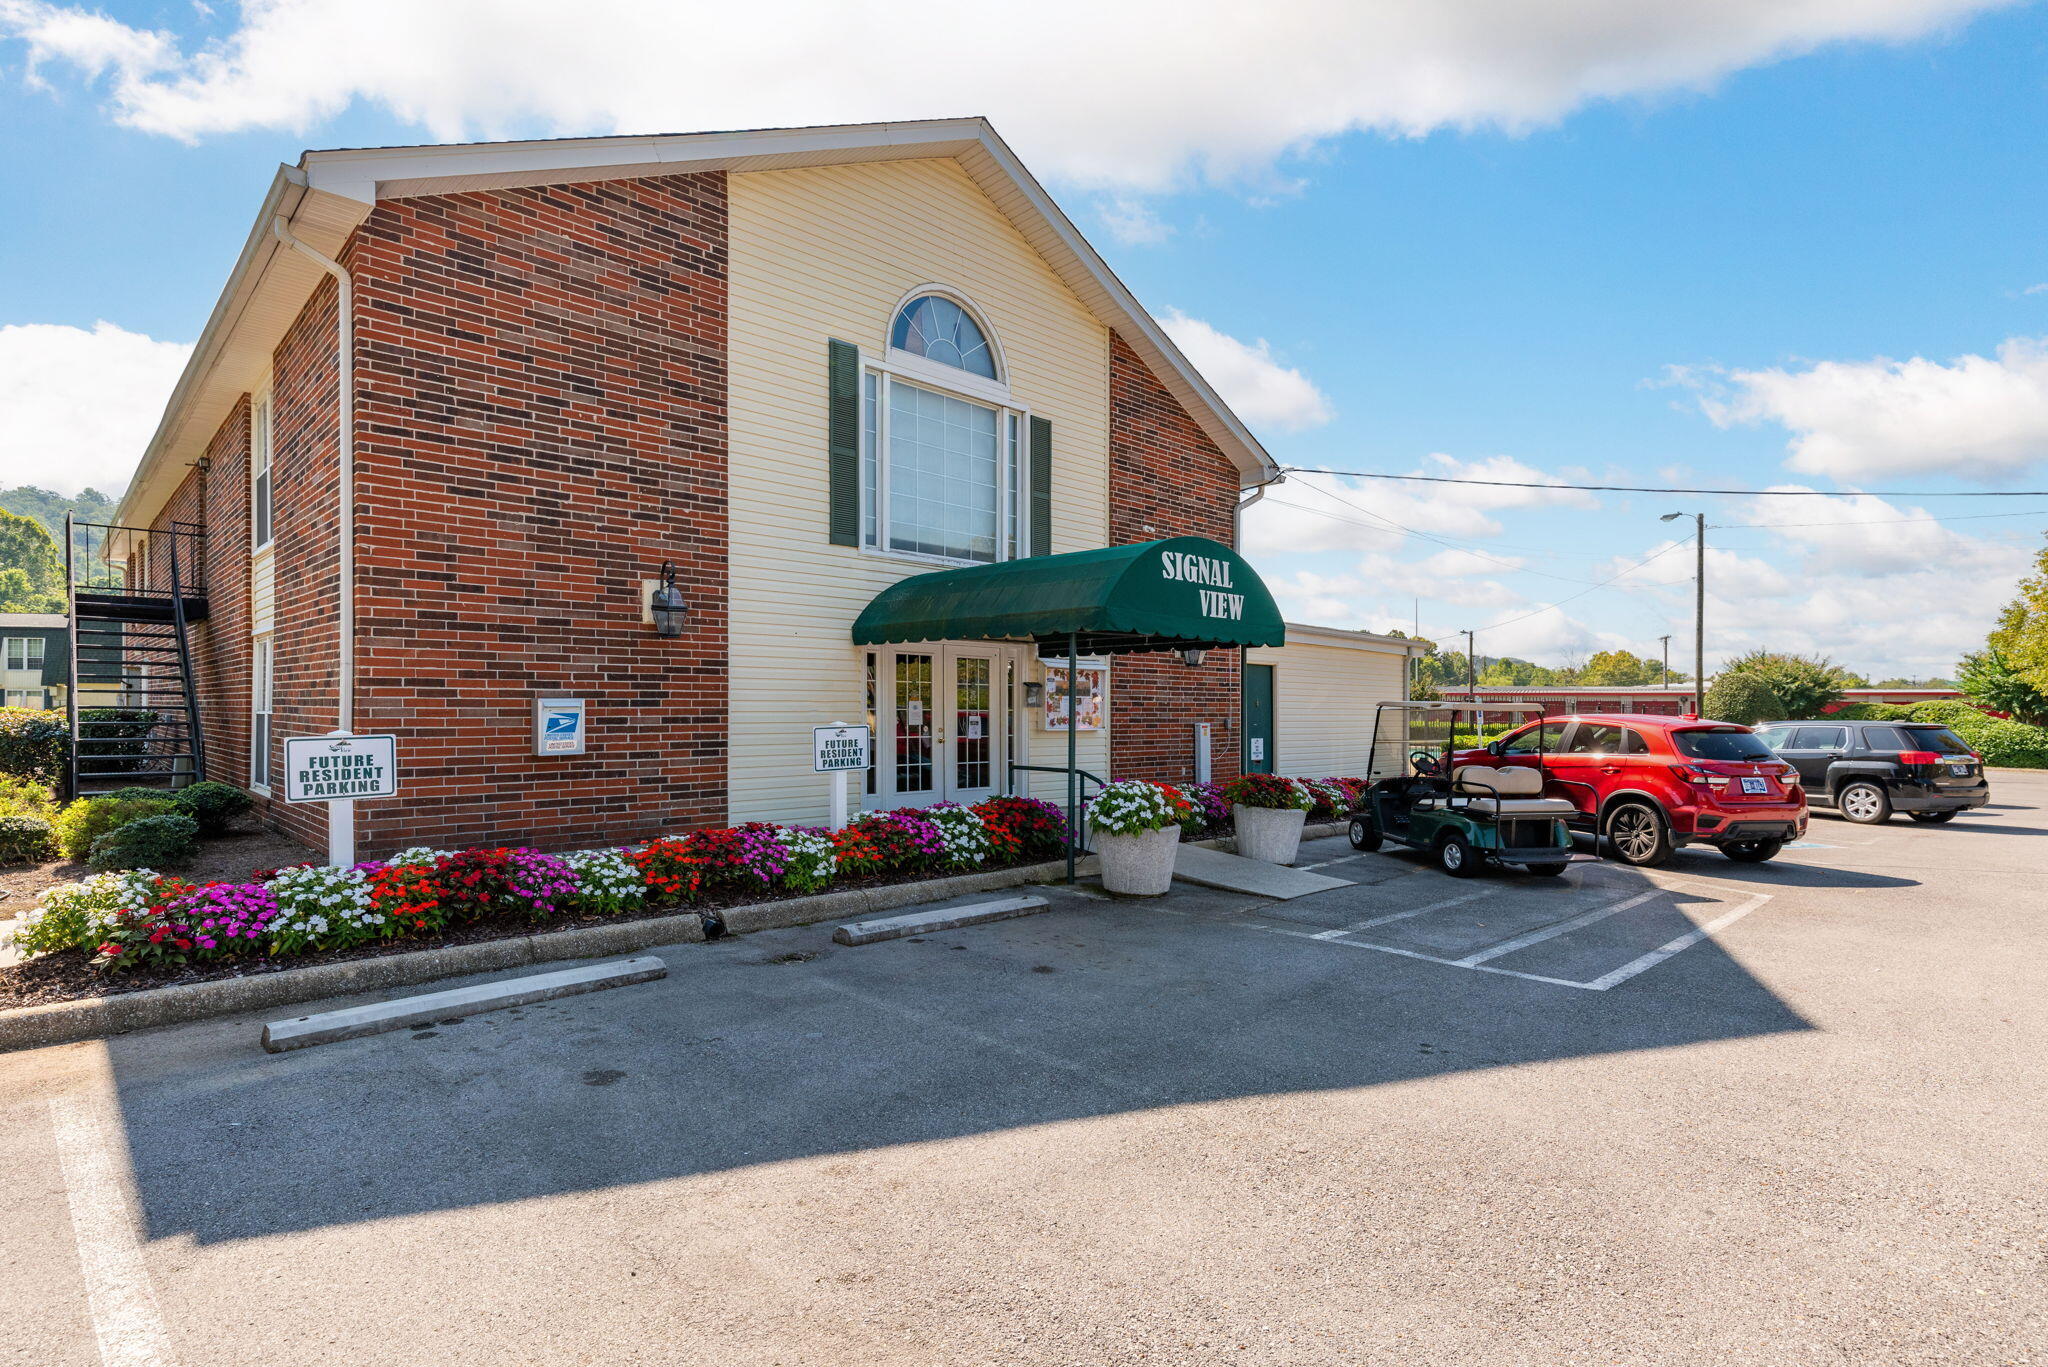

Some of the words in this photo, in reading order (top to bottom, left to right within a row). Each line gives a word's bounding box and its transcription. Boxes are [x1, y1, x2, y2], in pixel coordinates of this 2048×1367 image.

[1161, 550, 1233, 588] SIGNAL
[1199, 589, 1244, 621] VIEW
[825, 739, 859, 749] FUTURE
[820, 748, 863, 759] RESIDENT
[309, 754, 374, 769] FUTURE
[822, 757, 862, 768] PARKING
[299, 767, 383, 783] RESIDENT
[303, 779, 380, 796] PARKING
